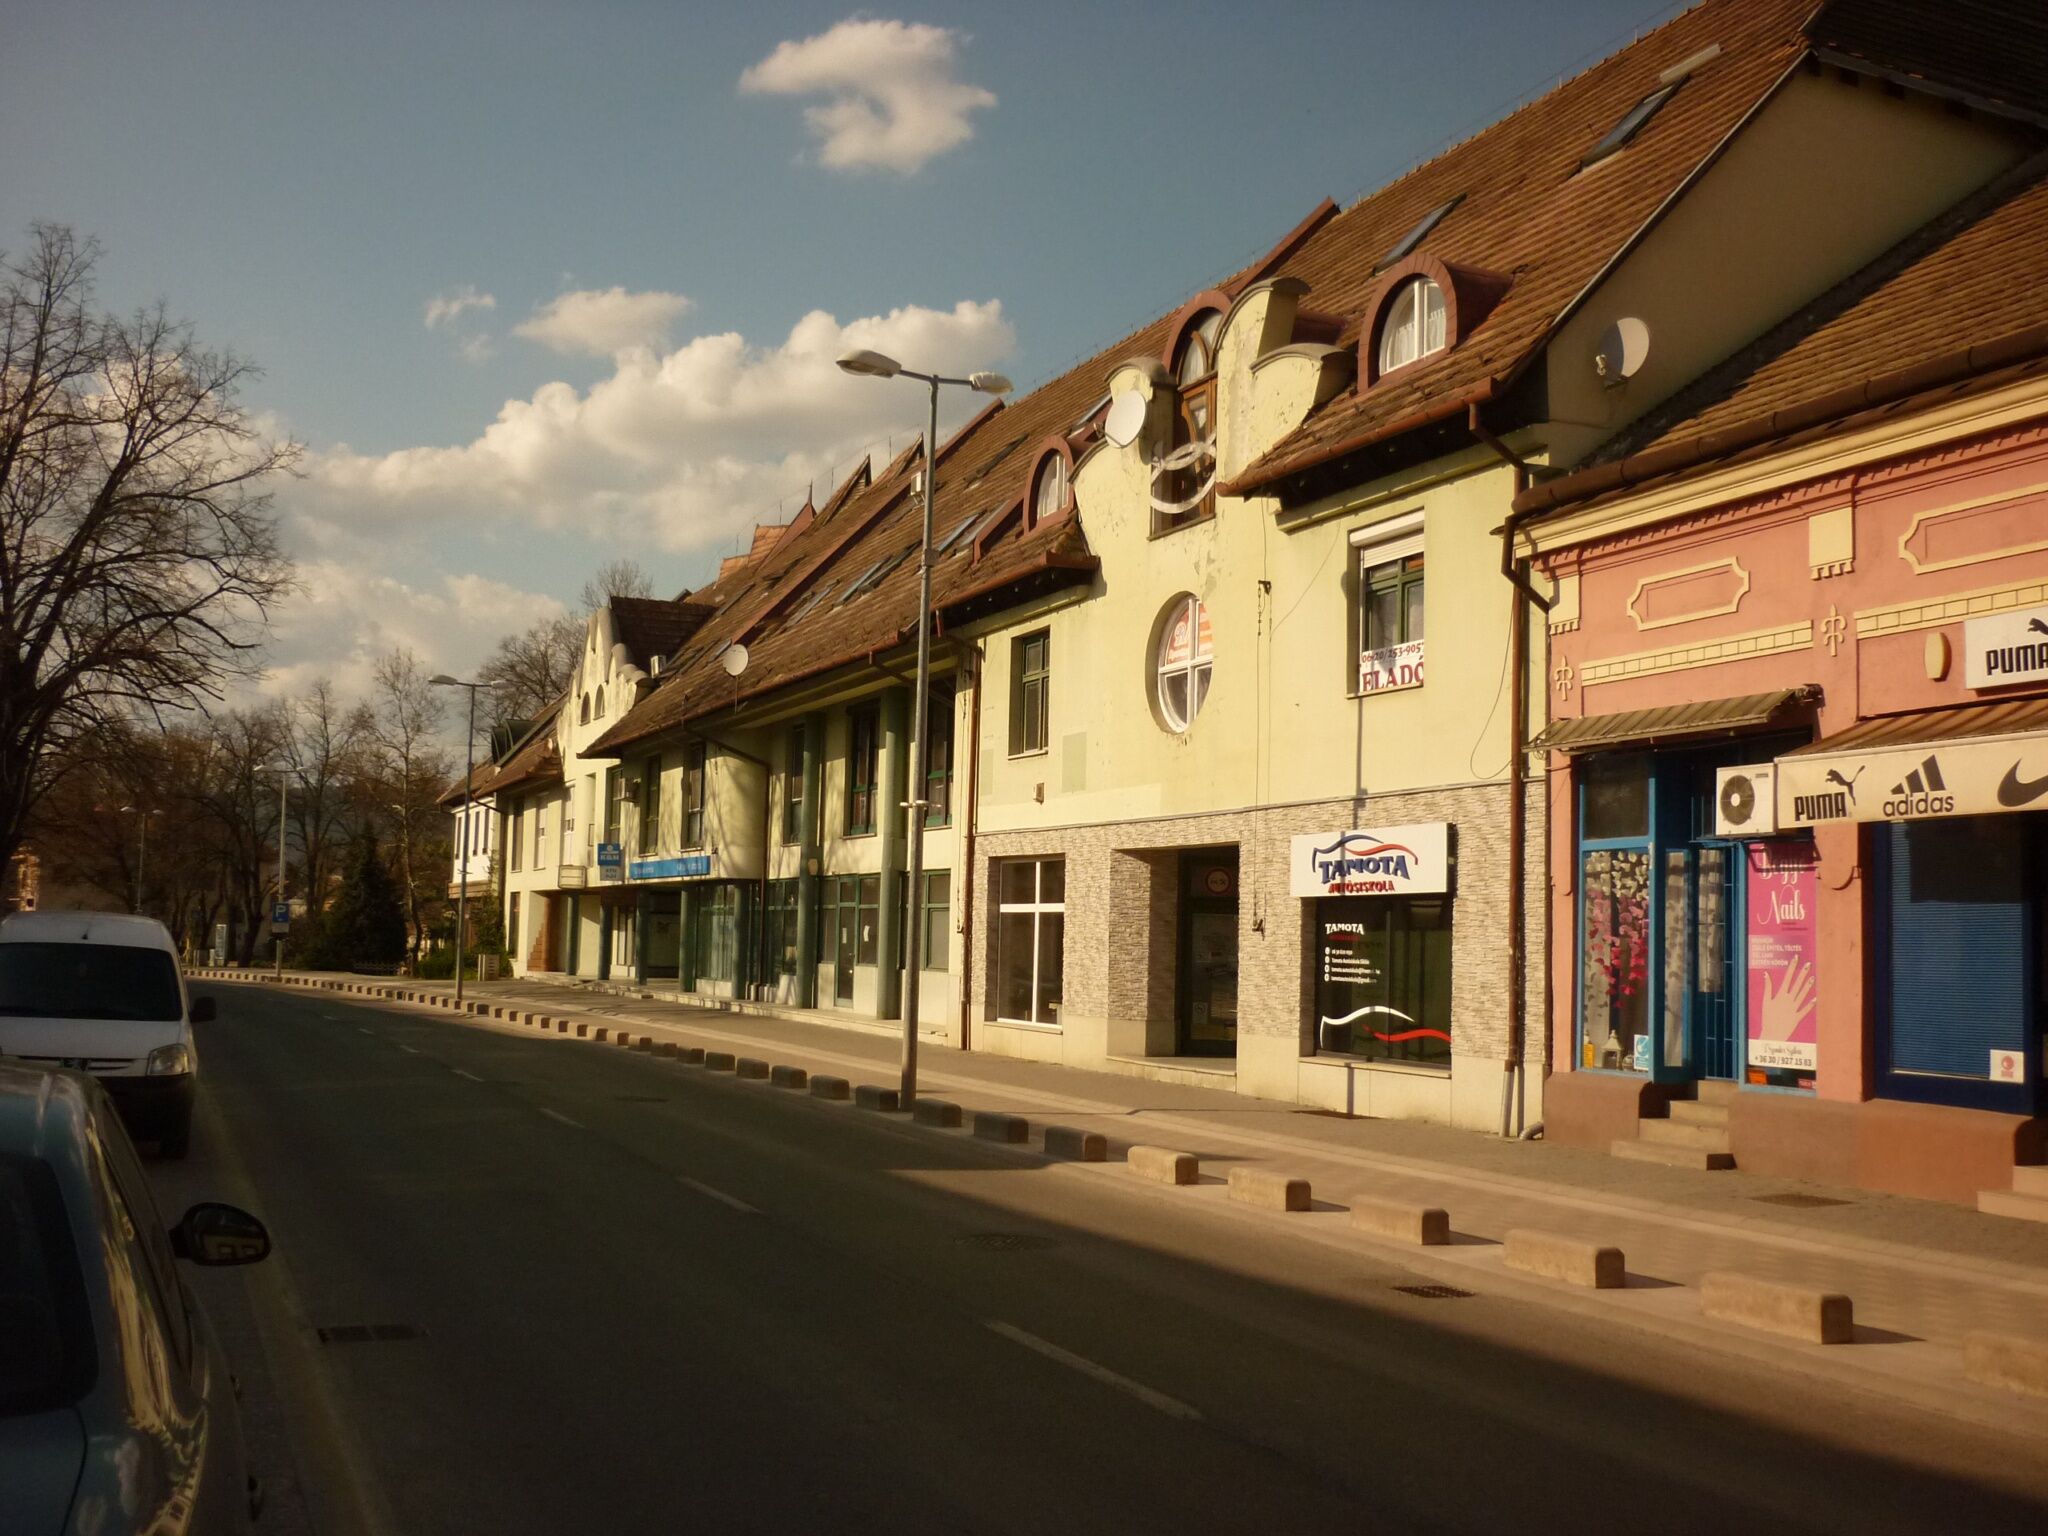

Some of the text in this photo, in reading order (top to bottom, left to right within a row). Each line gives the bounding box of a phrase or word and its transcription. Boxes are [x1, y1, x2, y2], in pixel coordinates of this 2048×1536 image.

[1986, 642, 2048, 676] PUMA
[1793, 791, 1847, 822] PUMA
[1882, 792, 1955, 818] adidas
[1319, 855, 1410, 884] TAMOTA
[275, 905, 286, 917] P
[1757, 885, 1806, 925] Nails
[1325, 923, 1365, 935] TAMOTA
